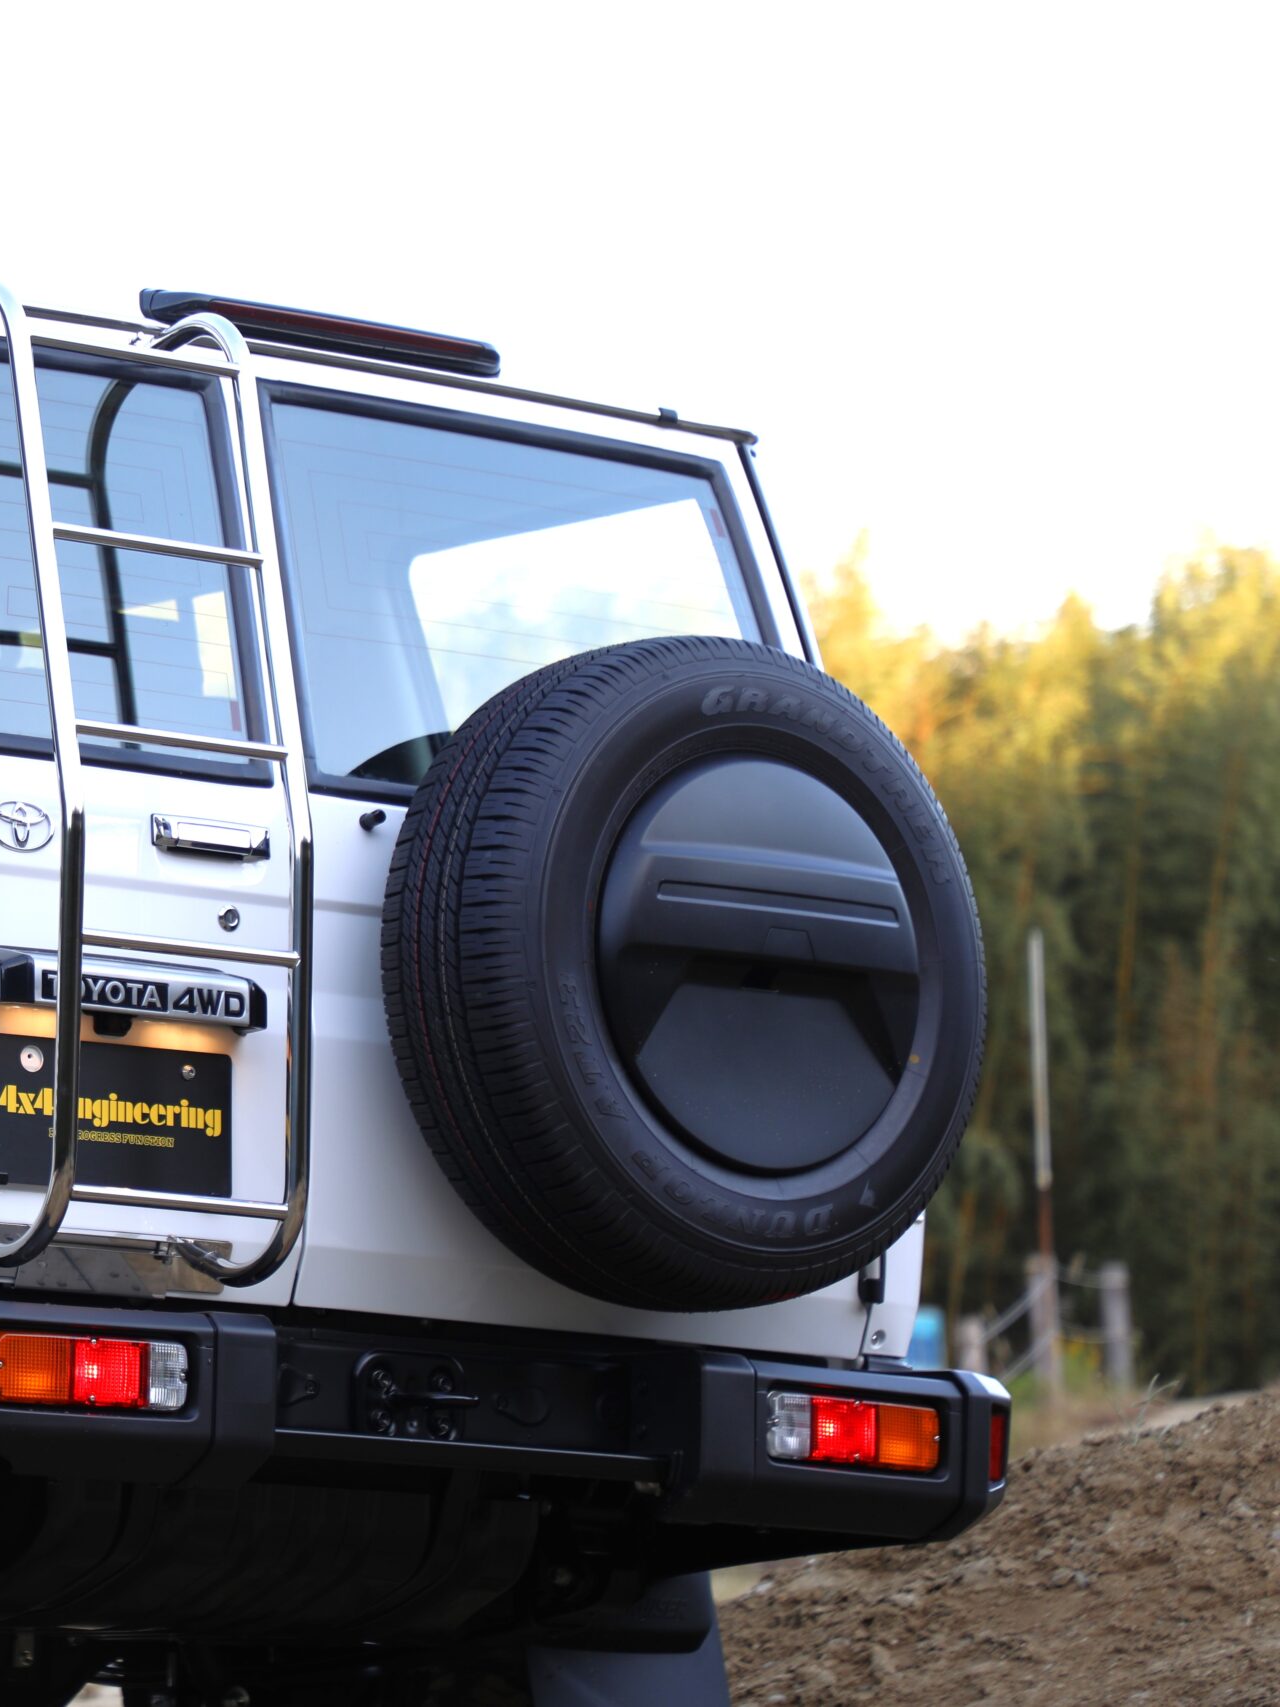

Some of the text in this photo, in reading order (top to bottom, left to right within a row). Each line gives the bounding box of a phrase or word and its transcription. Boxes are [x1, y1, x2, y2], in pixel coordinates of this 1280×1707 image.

[700, 684, 952, 886] GRANDTREK
[47, 974, 245, 1018] TYOTA 4WD
[78, 1093, 222, 1137] ngineering
[78, 1130, 122, 1144] ROGRESS
[628, 1148, 837, 1240] DUNLOP
